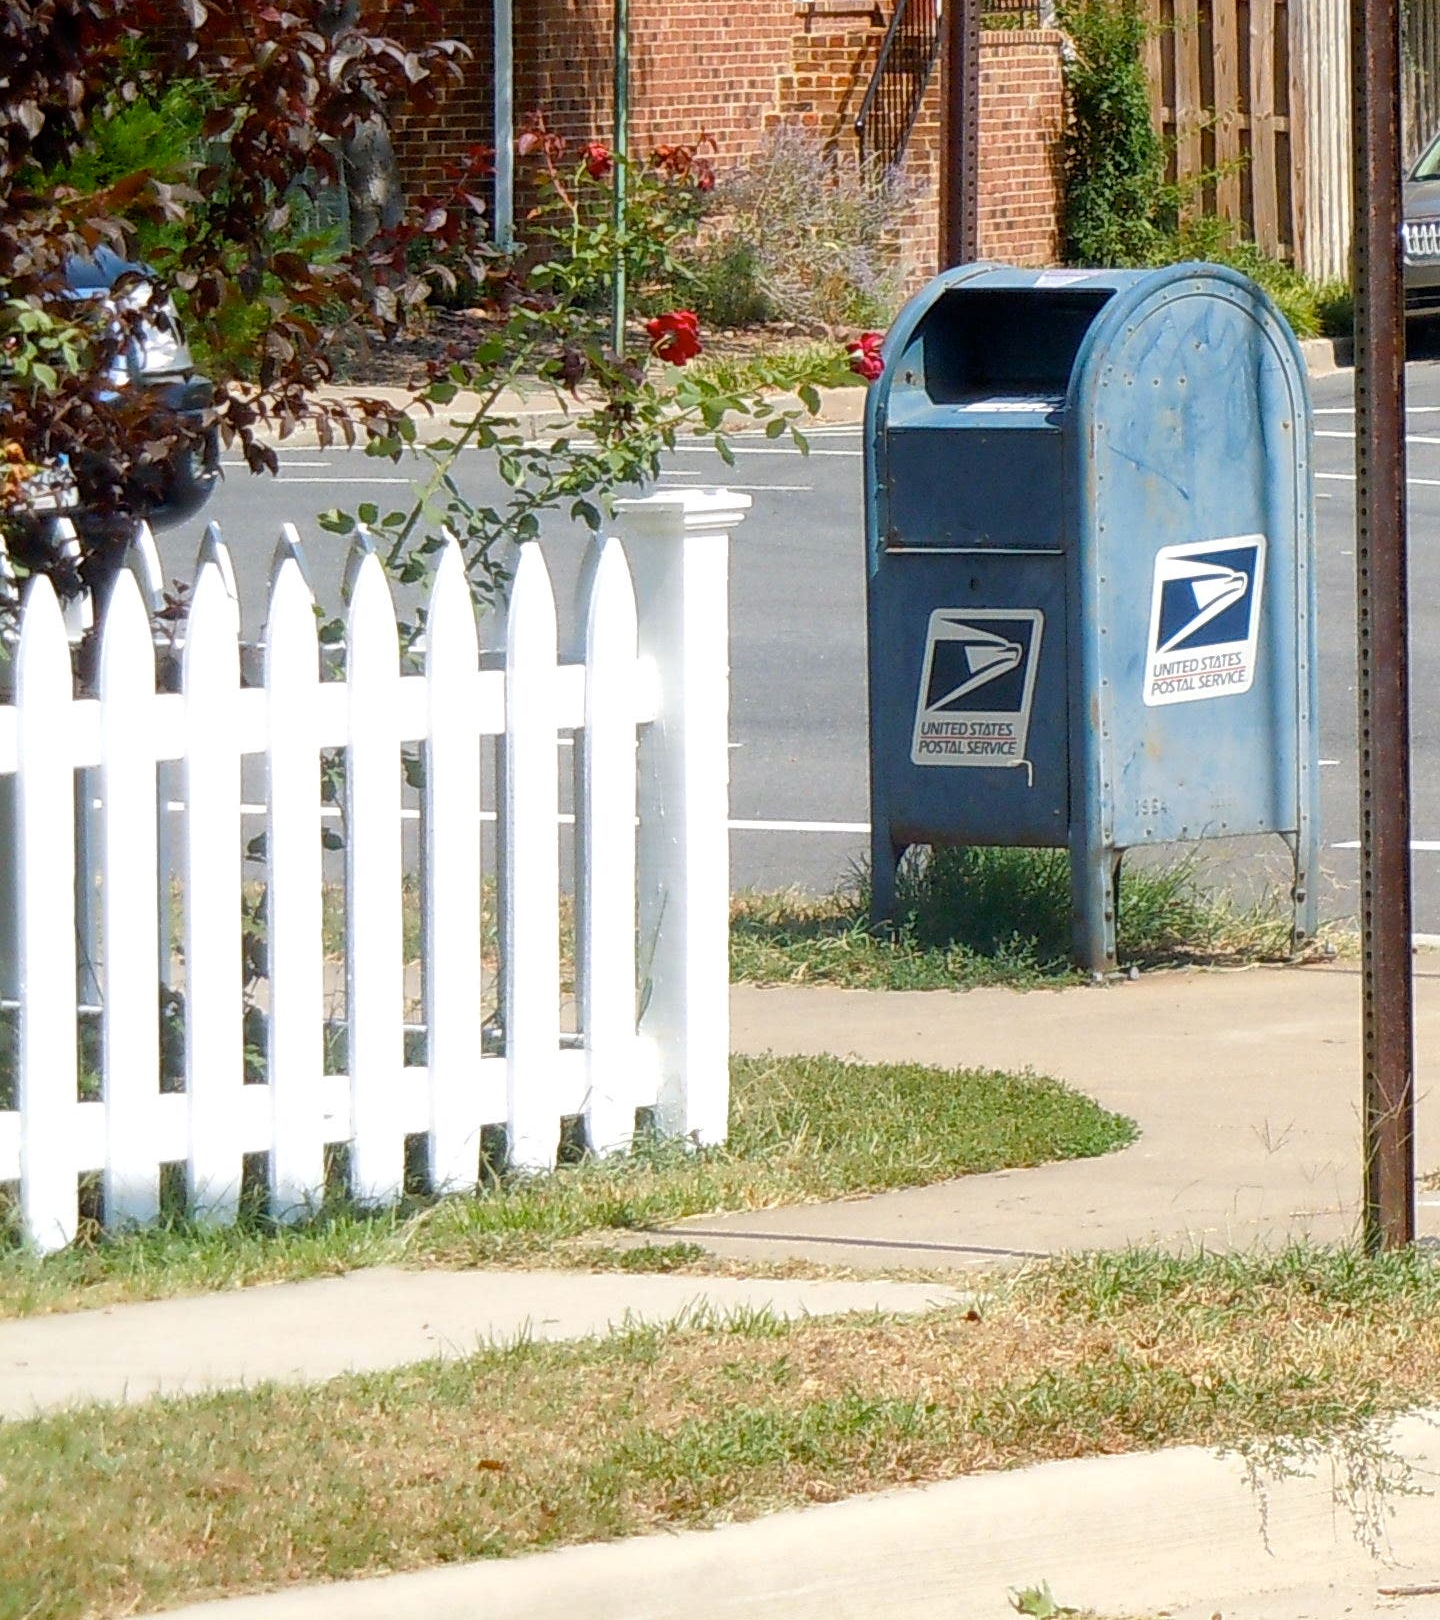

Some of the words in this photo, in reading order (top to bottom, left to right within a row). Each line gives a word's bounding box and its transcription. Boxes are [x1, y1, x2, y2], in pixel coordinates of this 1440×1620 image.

[1153, 658, 1199, 677] UNITED
[1201, 652, 1242, 670] STATES
[1151, 678, 1195, 696] POSTAL
[1198, 670, 1246, 689] SERVICE
[921, 722, 968, 735] UNITED
[969, 723, 1013, 736] STATES
[918, 740, 964, 754] POSTAL
[966, 741, 1018, 755] SERVICE
